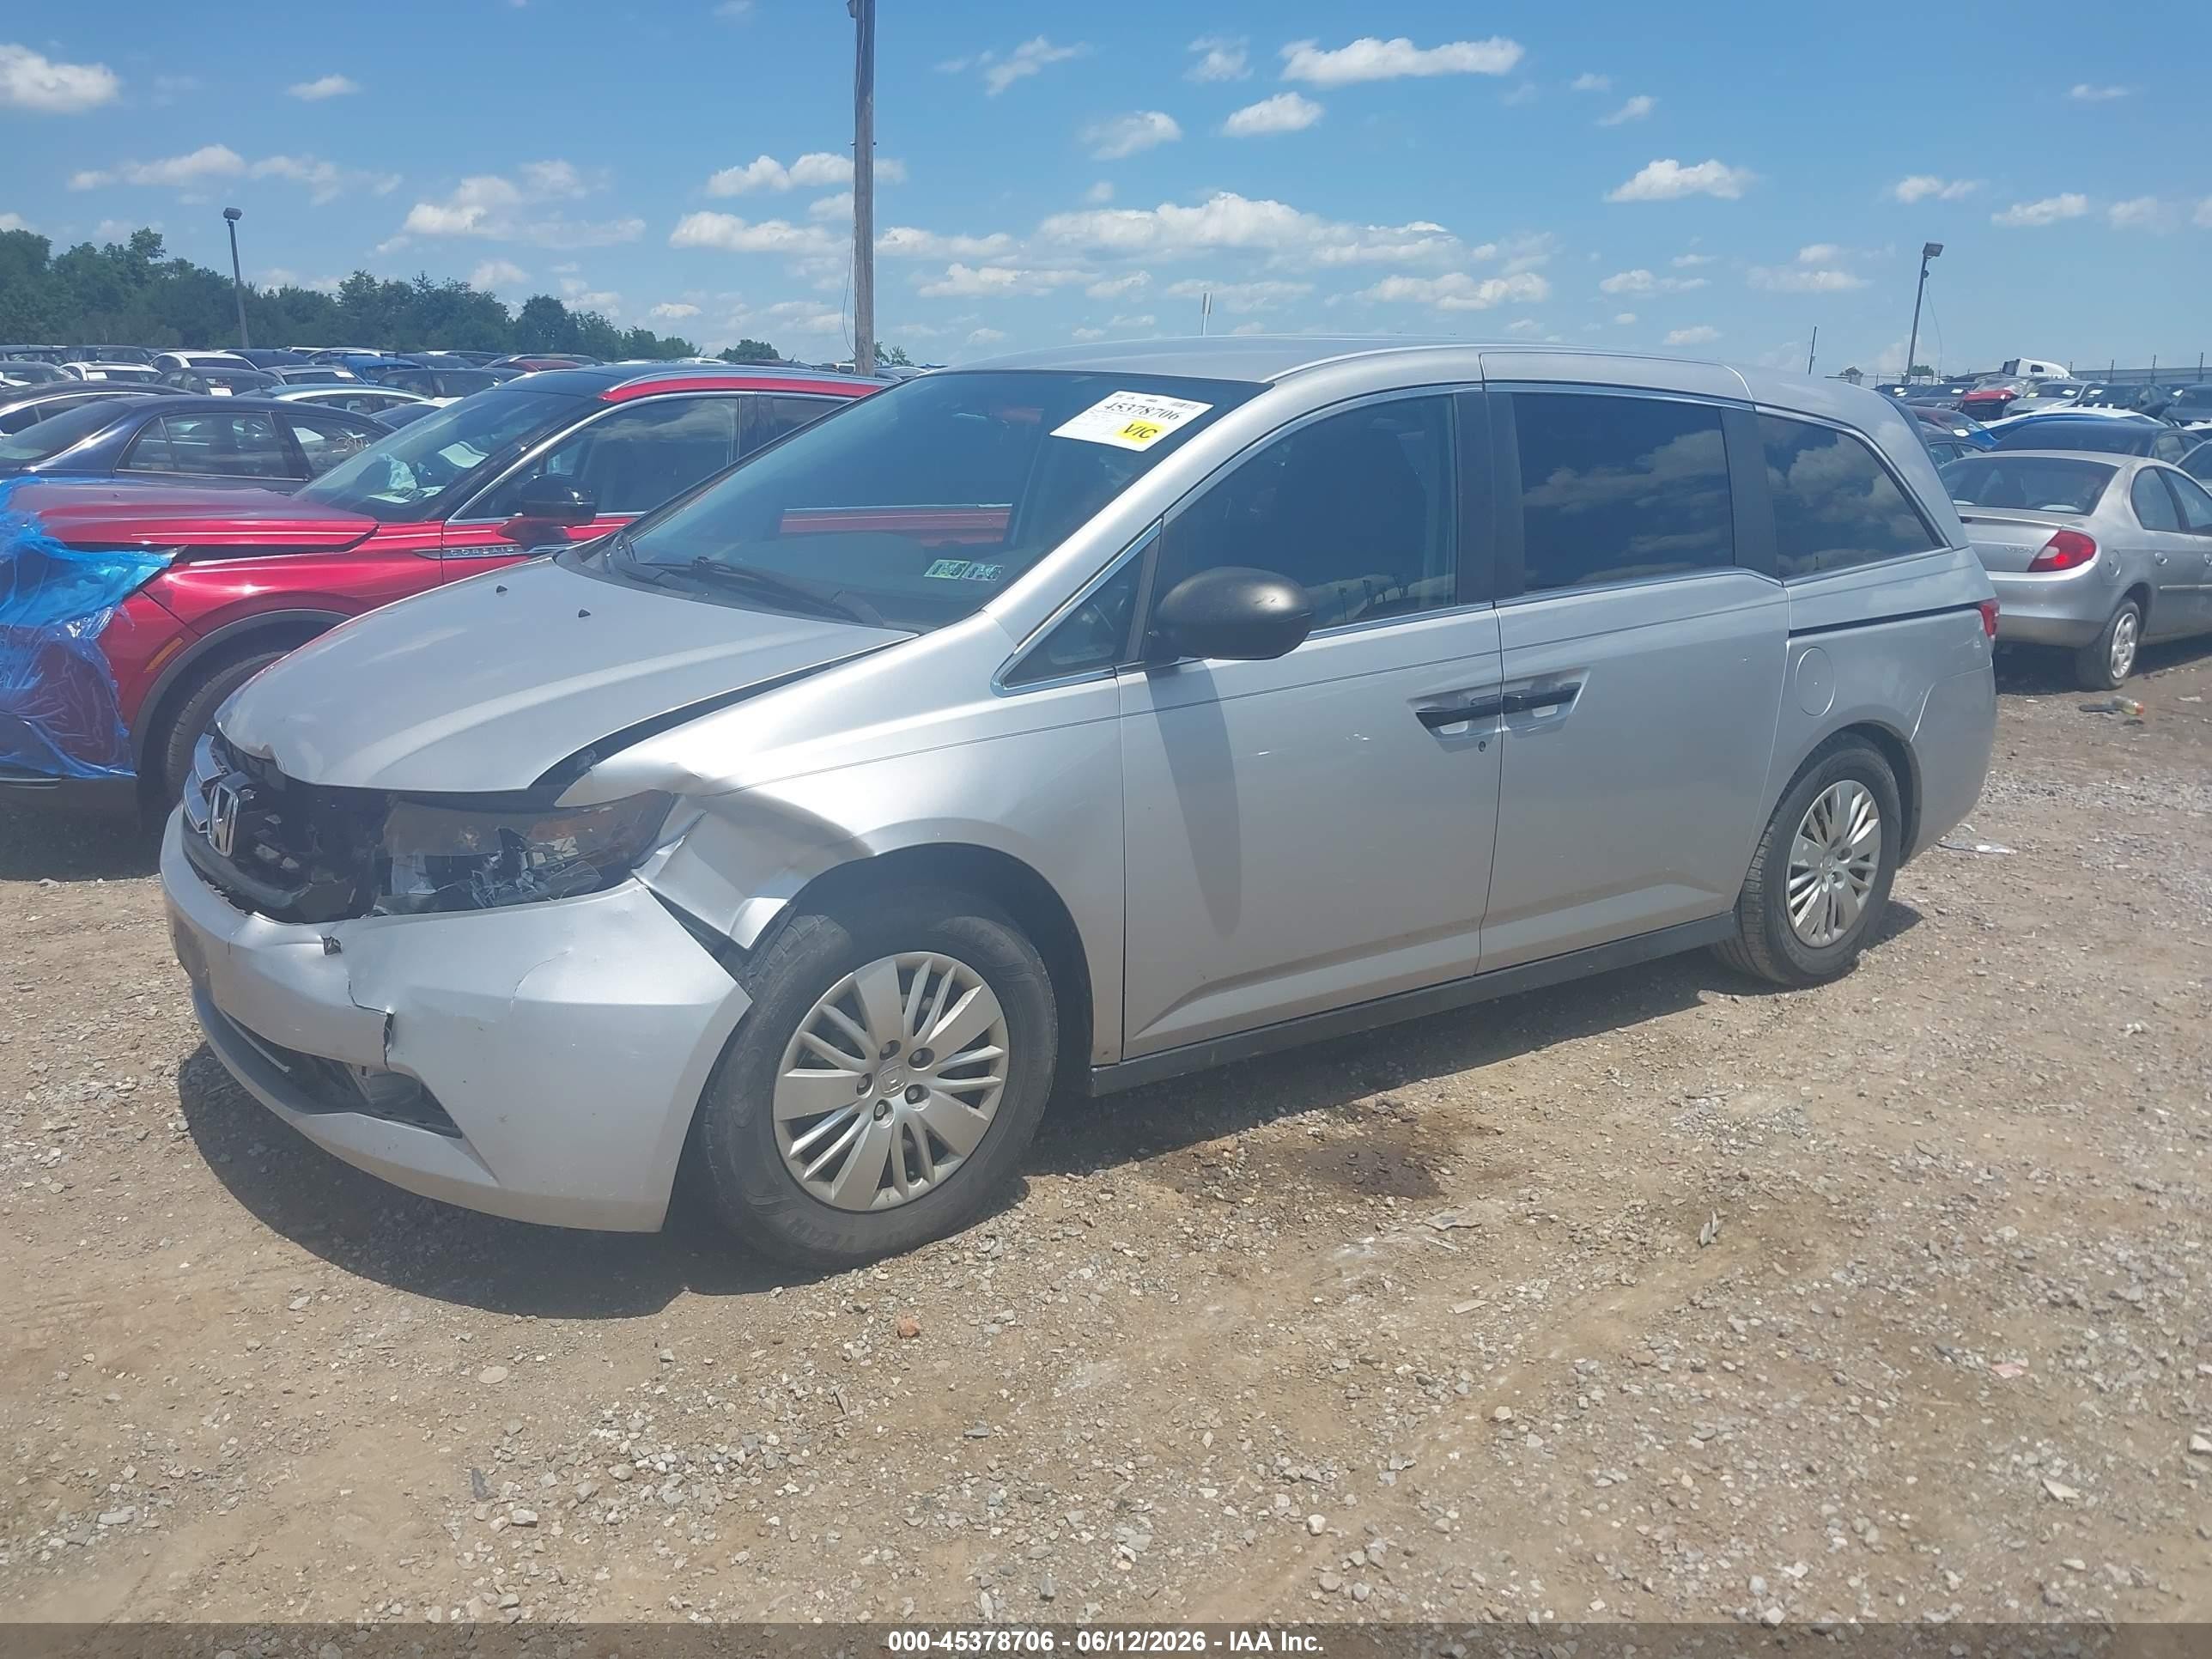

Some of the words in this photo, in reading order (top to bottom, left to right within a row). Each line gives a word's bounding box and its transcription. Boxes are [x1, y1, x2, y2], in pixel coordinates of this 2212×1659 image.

[1103, 401, 1182, 421] 45378706
[1123, 422, 1158, 440] VIC
[450, 546, 514, 556] CORSAIR
